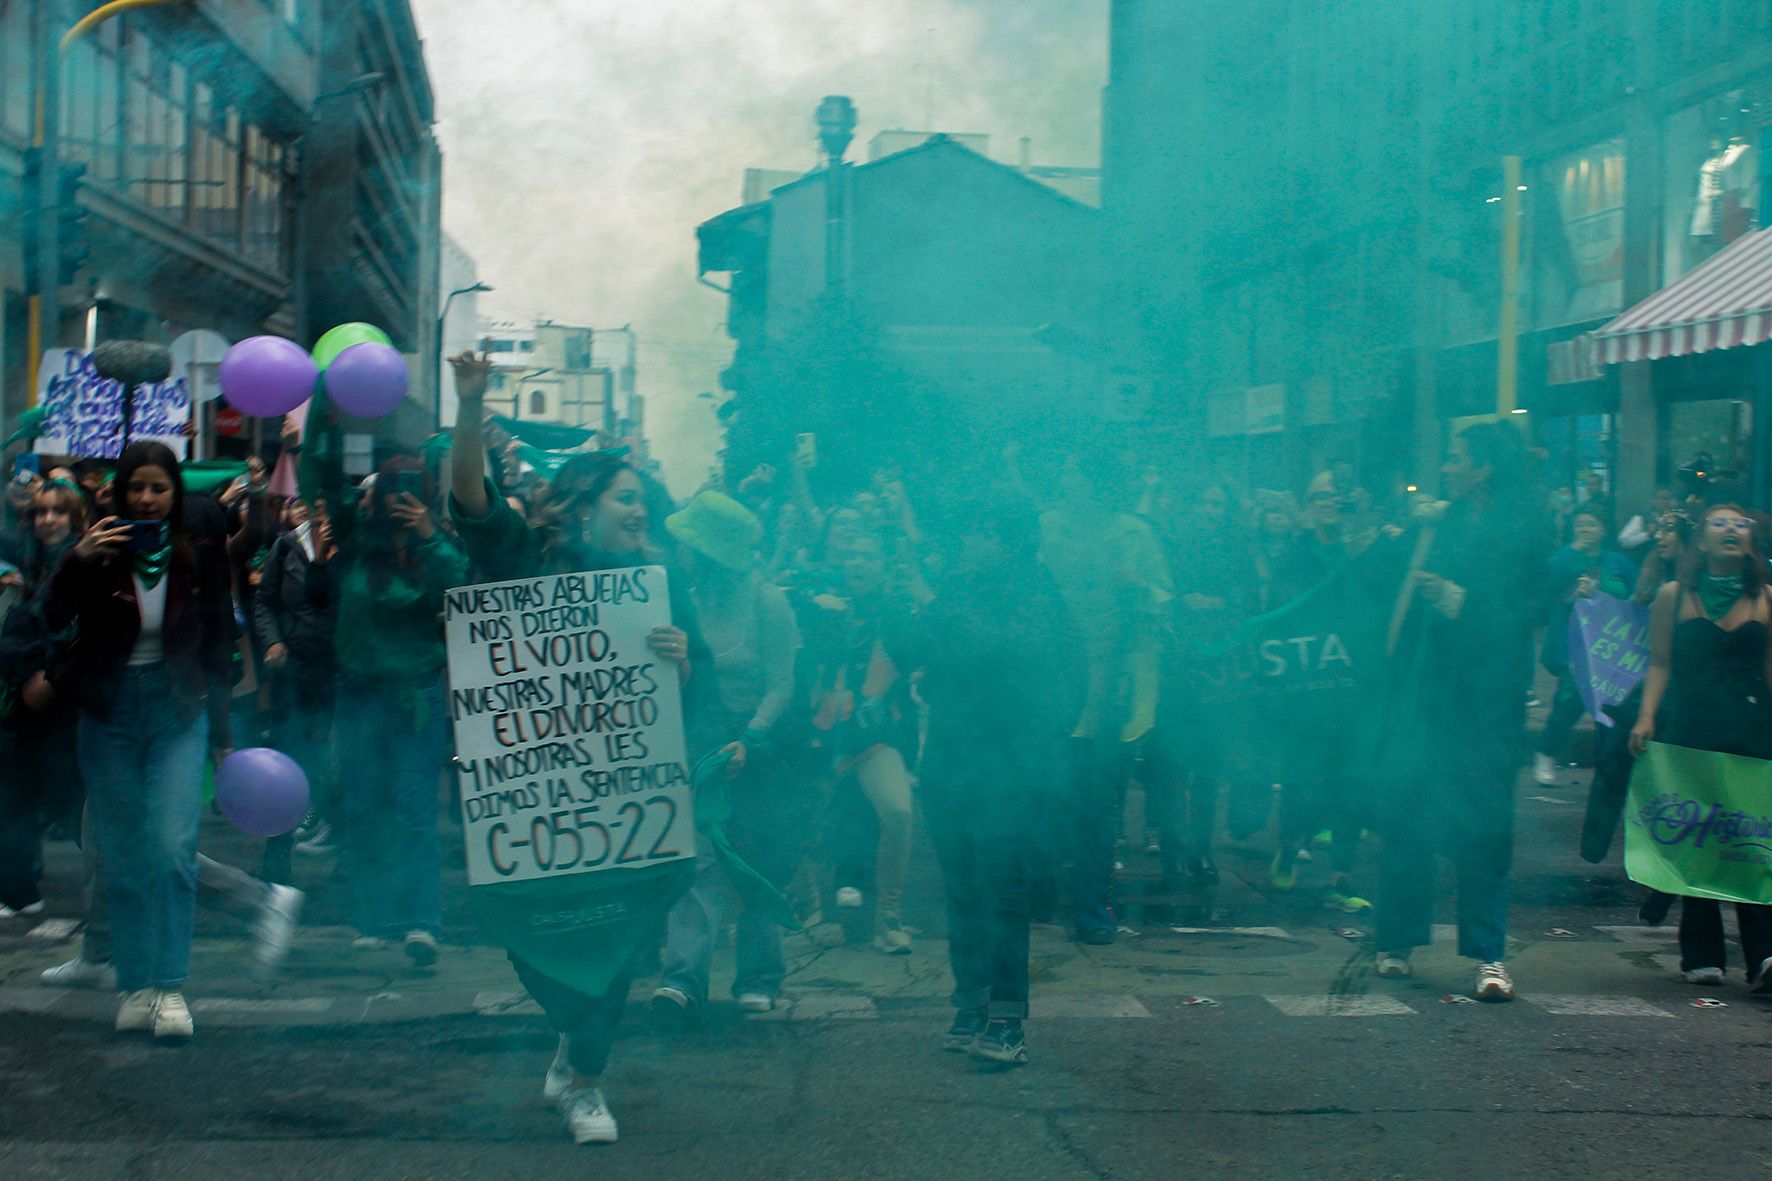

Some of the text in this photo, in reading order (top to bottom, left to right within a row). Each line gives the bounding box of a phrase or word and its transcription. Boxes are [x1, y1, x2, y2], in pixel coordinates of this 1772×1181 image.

[446, 568, 649, 620] NUESTRAS ABUELAS
[469, 603, 598, 644] NOS DIERON
[1601, 615, 1633, 641] LA
[488, 629, 618, 677] EL VOTO,
[1589, 637, 1648, 674] ES MI
[451, 662, 658, 721] NUESTRAS MADRES
[1590, 675, 1627, 702] CAUS
[493, 696, 658, 748] EL DIVORCIO
[459, 730, 649, 791] Y NOSOTRAS LES
[466, 761, 690, 823] DIMOS LA SENTENCIA
[486, 795, 680, 877] C-055-22
